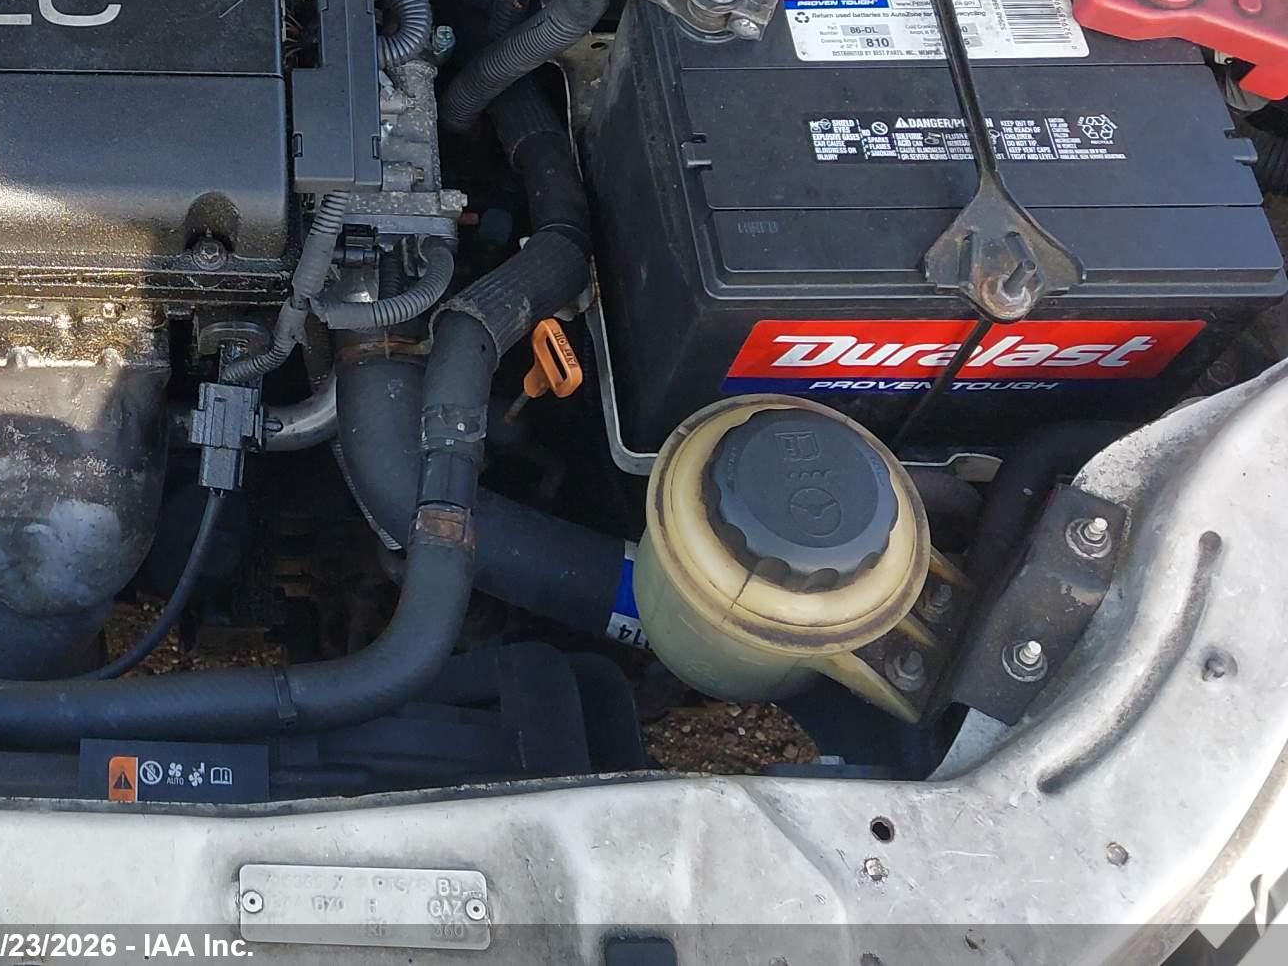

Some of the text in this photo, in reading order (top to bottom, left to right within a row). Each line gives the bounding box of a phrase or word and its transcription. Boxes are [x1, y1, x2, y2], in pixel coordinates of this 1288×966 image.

[849, 26, 879, 35] 86-DL
[866, 37, 890, 49] 810
[771, 335, 1158, 369] Duralast
[809, 380, 1061, 391] PROVEN TOUGH
[166, 776, 184, 786] AUTO
